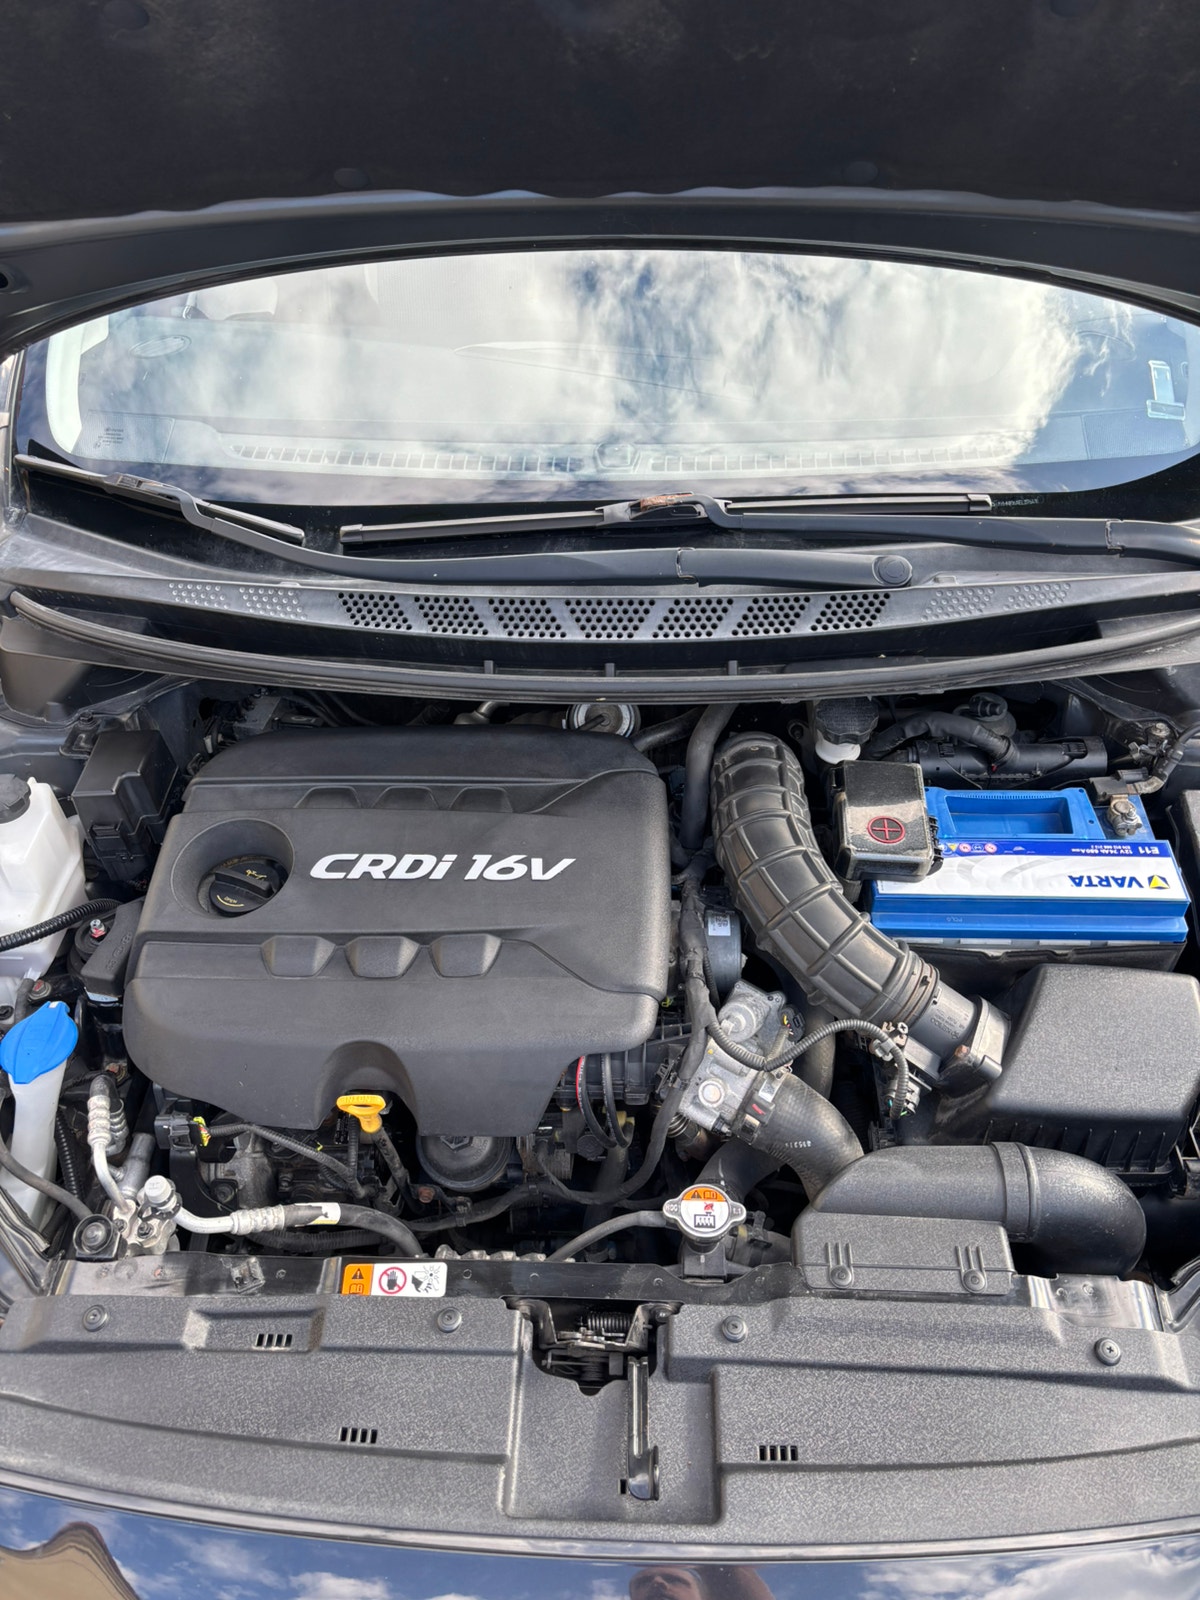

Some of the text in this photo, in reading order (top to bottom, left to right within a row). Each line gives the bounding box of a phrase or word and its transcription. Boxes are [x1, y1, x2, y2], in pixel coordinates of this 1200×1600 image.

[1138, 846, 1160, 854] E11
[310, 853, 577, 881] CRDi 16V
[1068, 875, 1144, 888] VARTA
